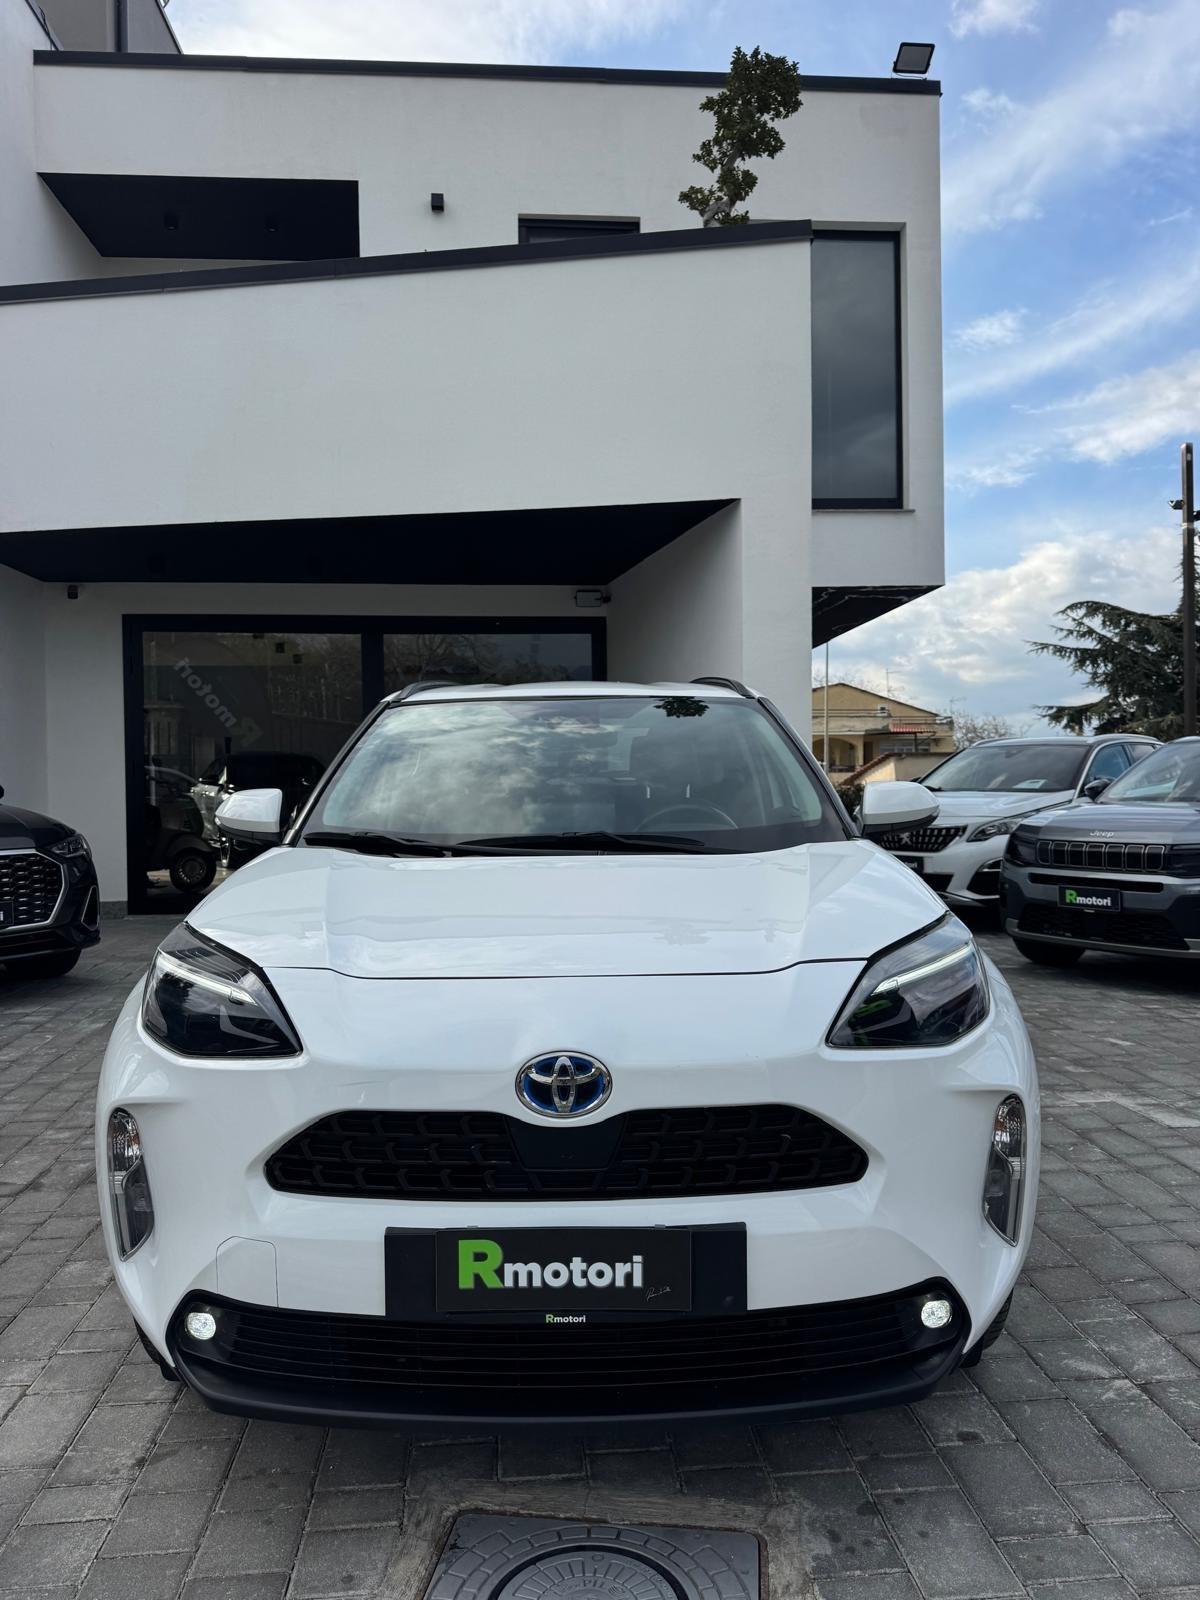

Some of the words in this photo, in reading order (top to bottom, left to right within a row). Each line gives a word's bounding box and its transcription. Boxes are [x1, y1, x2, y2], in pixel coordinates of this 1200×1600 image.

[1089, 830, 1115, 838] Jeep
[1065, 889, 1112, 907] Rmotori
[458, 1239, 644, 1290] Rmotori
[545, 1313, 586, 1324] Rmotori
